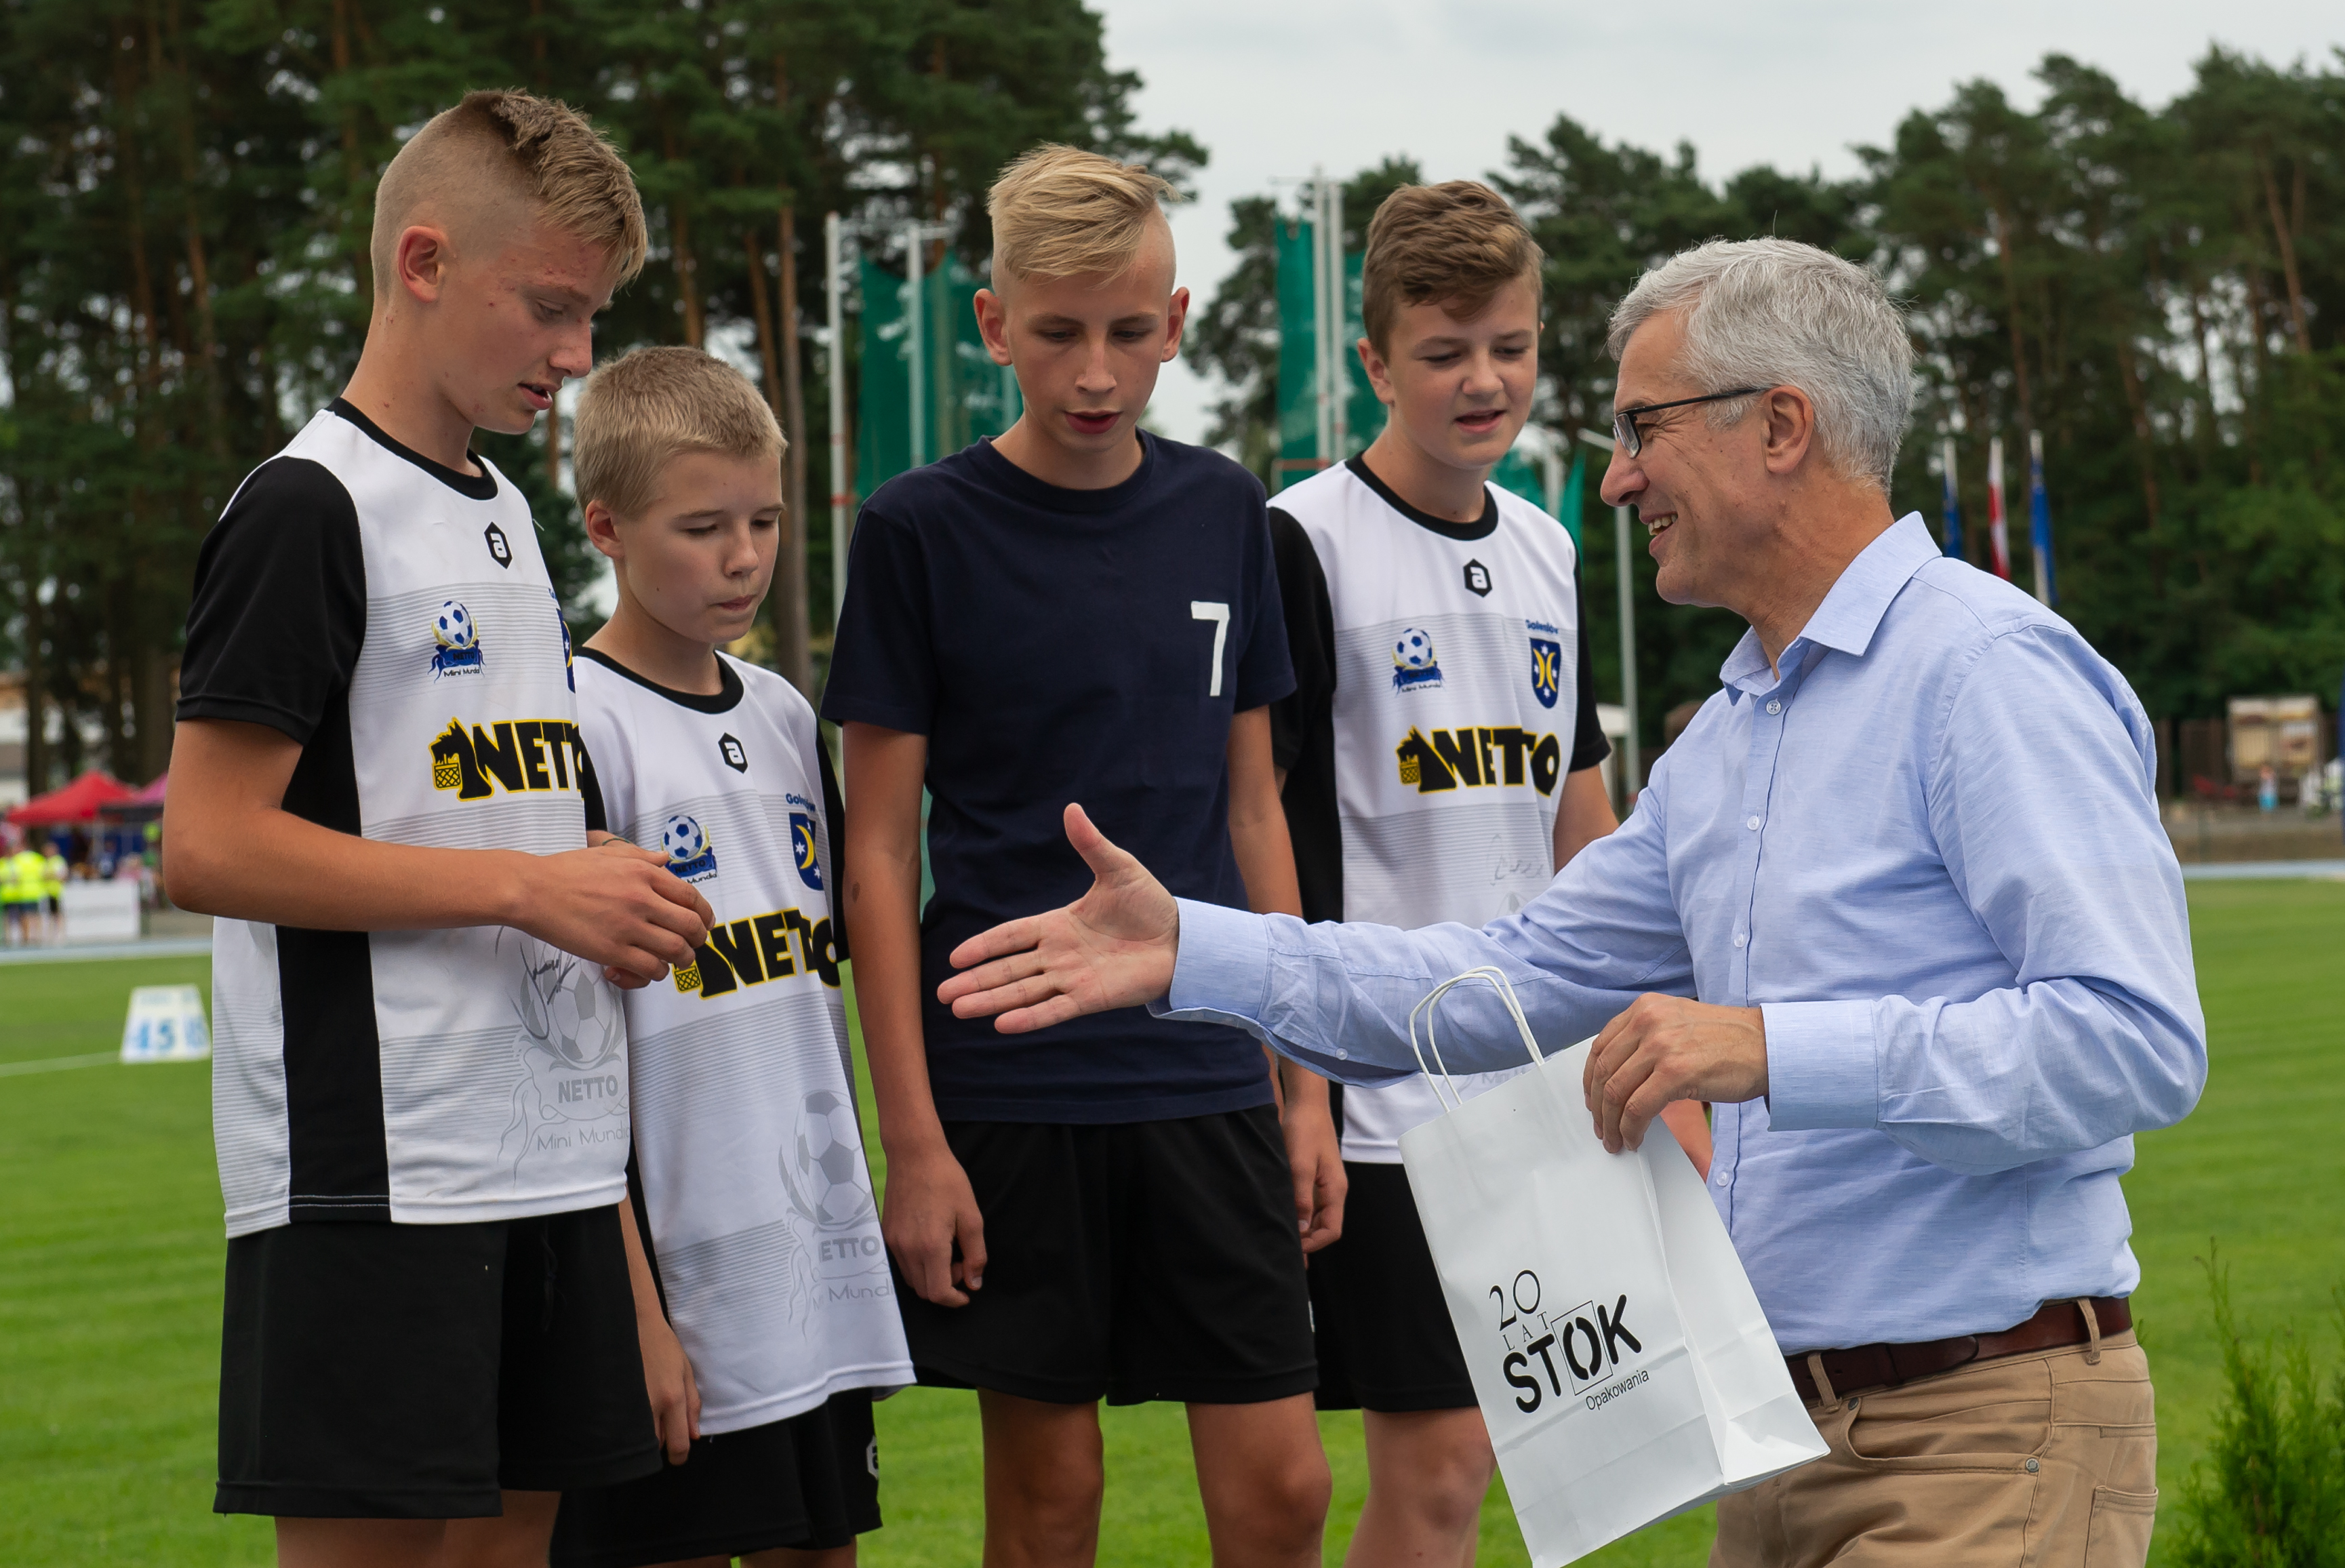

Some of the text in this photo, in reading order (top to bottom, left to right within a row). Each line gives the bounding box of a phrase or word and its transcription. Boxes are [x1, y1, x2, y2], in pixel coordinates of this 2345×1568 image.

[1190, 601, 1230, 697] 7
[675, 859, 706, 874] NETTO
[558, 1074, 618, 1104] NETTO
[538, 1131, 572, 1151] Mini
[1489, 1269, 1541, 1331] 20
[1502, 1311, 1549, 1351] LAT
[1503, 1293, 1642, 1413] STOK
[1585, 1369, 1649, 1411] Opakowania
